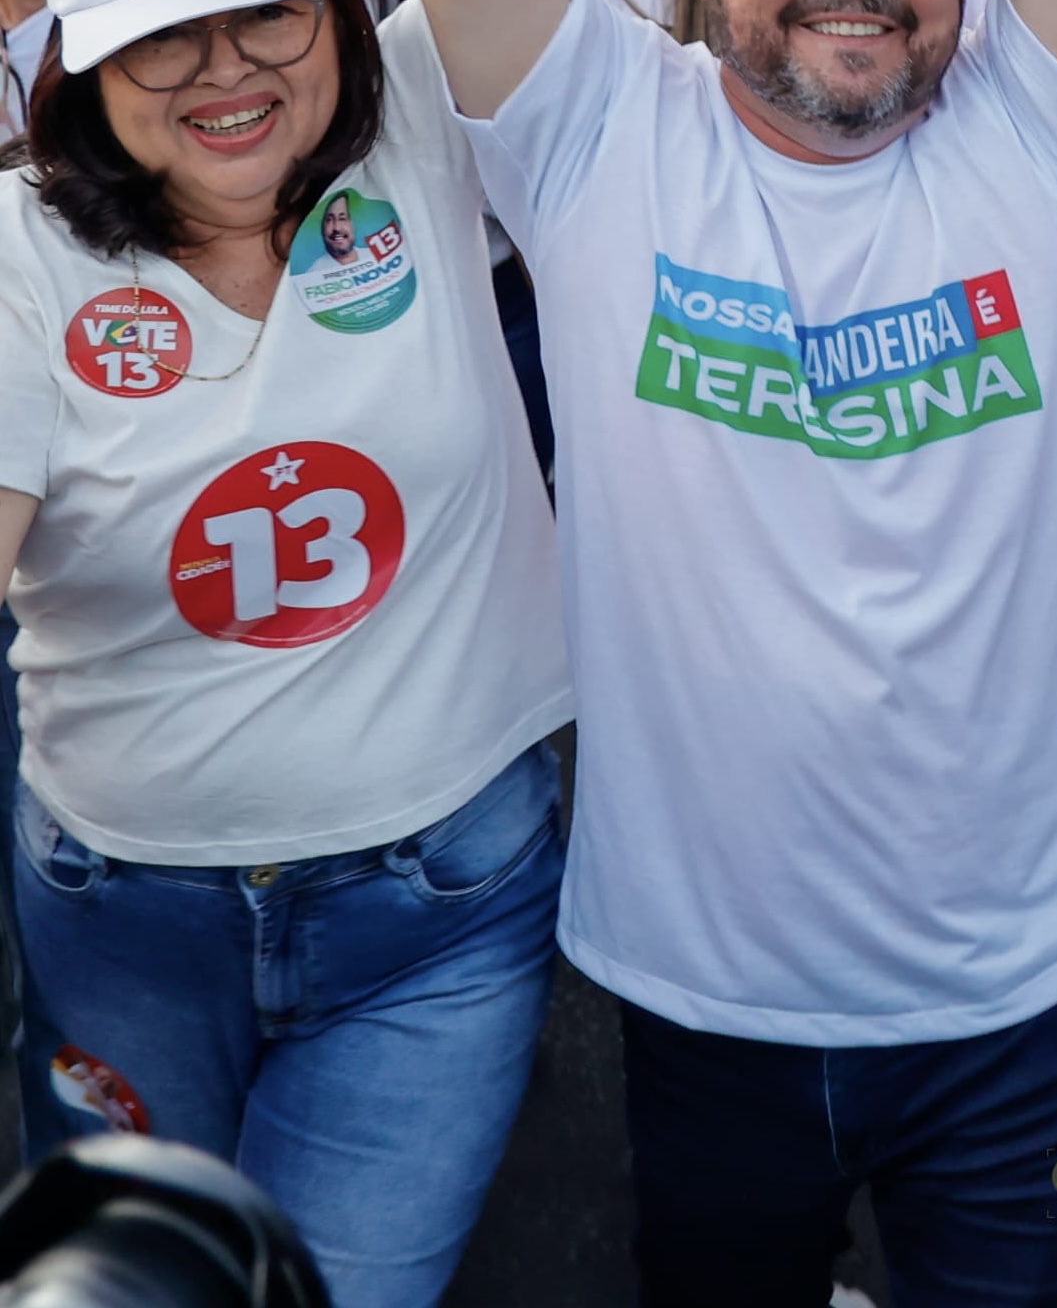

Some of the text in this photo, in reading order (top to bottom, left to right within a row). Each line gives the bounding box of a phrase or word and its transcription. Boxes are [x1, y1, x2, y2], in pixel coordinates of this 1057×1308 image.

[368, 225, 402, 255] 13
[94, 304, 122, 314] TIME
[140, 305, 169, 315] LULA
[660, 273, 798, 343] NOSSA
[975, 288, 1001, 326] É
[81, 318, 179, 351] VOTE
[95, 351, 161, 390] 13
[203, 488, 372, 622] 13
